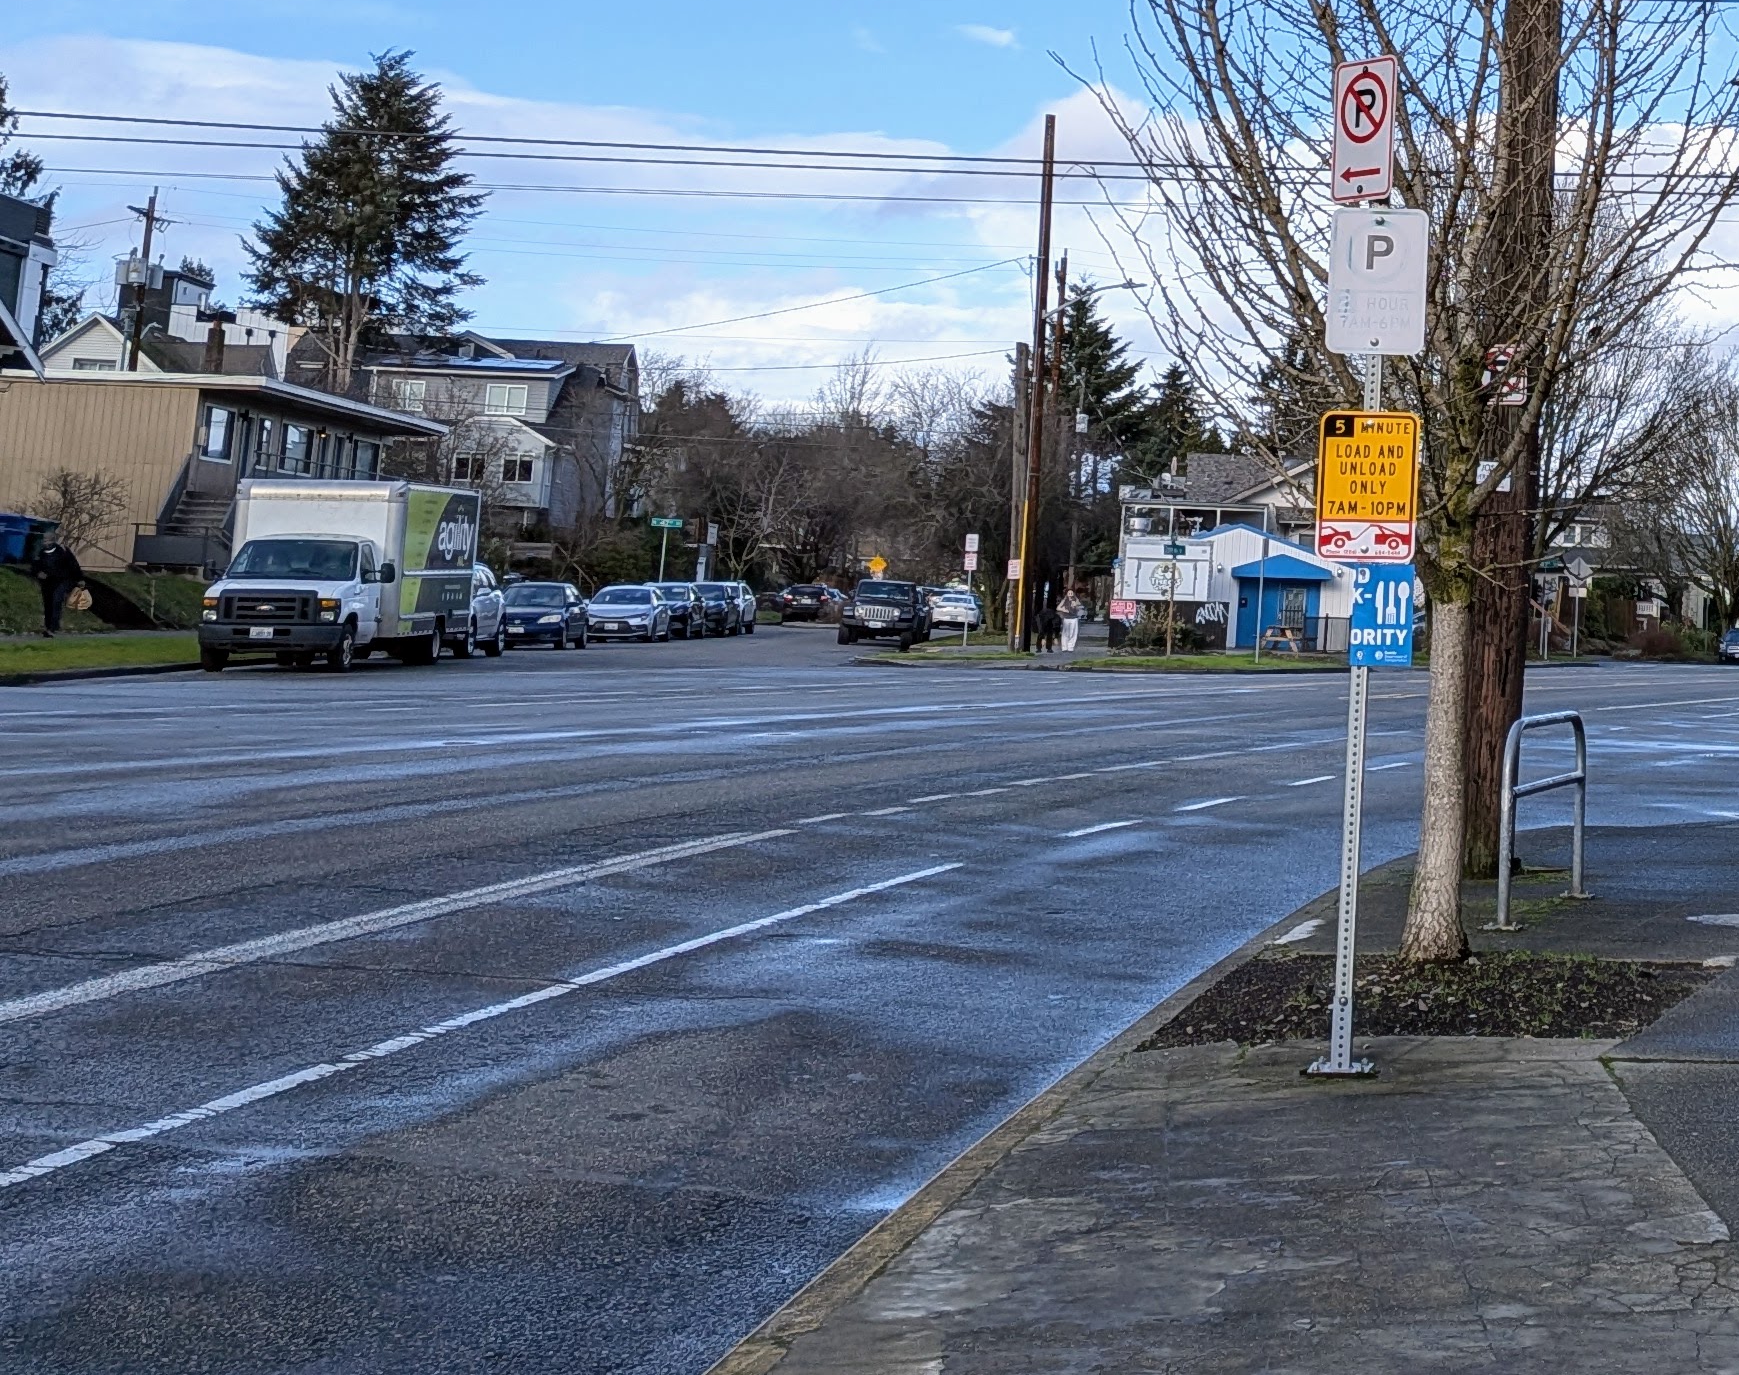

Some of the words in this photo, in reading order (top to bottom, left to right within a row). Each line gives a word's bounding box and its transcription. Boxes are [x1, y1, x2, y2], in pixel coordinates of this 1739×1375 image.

[1365, 235, 1395, 270] P
[1366, 297, 1409, 311] HOUR
[1334, 419, 1346, 434] 5
[1361, 422, 1411, 436] MINUTE
[1336, 444, 1371, 459] LOAD
[1378, 444, 1405, 459] AND
[1339, 461, 1397, 476] UNLOAD
[1349, 479, 1388, 495] ONLY
